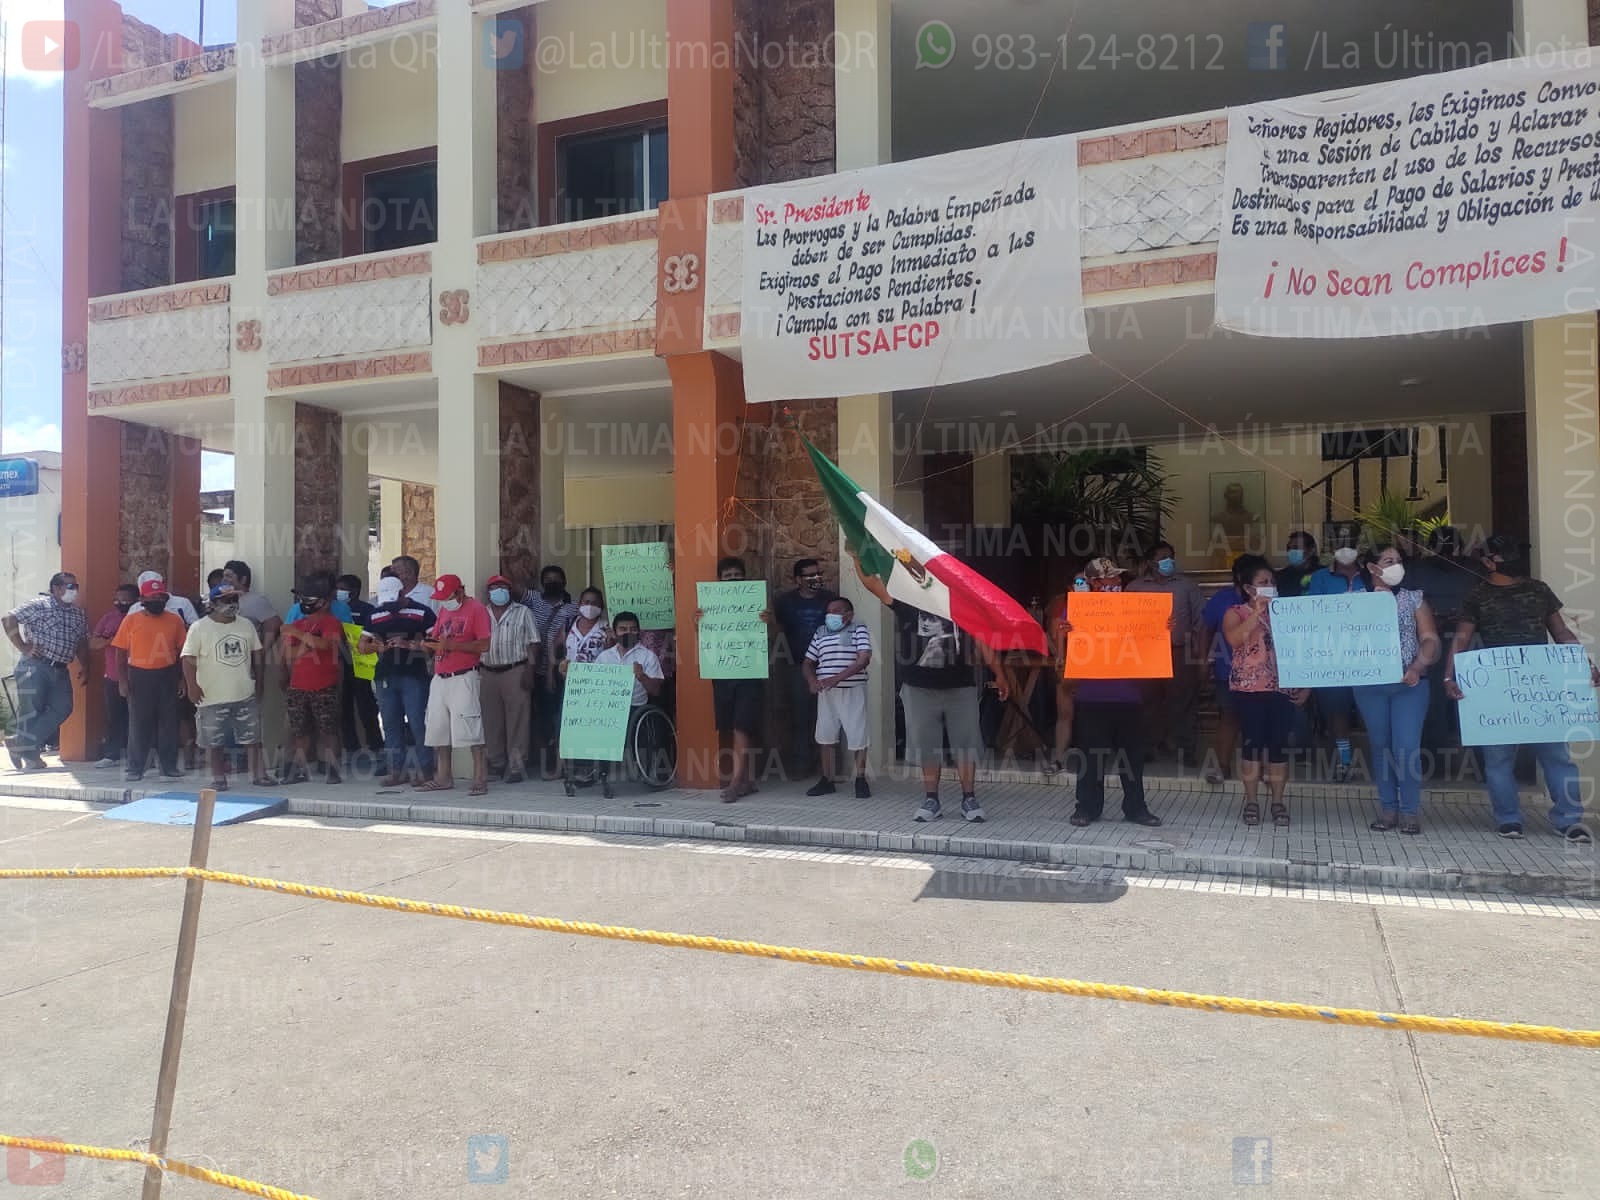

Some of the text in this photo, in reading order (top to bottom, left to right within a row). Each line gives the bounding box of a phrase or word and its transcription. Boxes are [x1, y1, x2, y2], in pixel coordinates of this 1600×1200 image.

[1277, 150, 1310, 164] una
[1317, 138, 1372, 165] Sesión
[1380, 133, 1401, 156] de
[1410, 118, 1479, 150] Cabildo
[1488, 119, 1501, 143] y
[1508, 107, 1588, 135] Aclarar
[1313, 112, 1401, 143] Regidores,
[1408, 101, 1434, 125] les
[1441, 88, 1526, 118] Exigimos
[1383, 158, 1398, 181] el
[1405, 157, 1435, 176] uso
[1446, 145, 1467, 169] de
[1475, 143, 1503, 165] los
[756, 188, 871, 226] Sr. Presidente
[783, 224, 846, 248] Prorrogas
[852, 221, 861, 241] y
[867, 213, 879, 232] la
[886, 205, 939, 228] Palabra
[946, 181, 1036, 221] Empeñada
[1232, 214, 1249, 236] Es
[1255, 220, 1288, 236] una
[1294, 206, 1428, 244] Responsabilidad
[1437, 208, 1450, 233] y
[1457, 191, 1554, 226] Obligación
[1561, 185, 1583, 209] de
[1315, 199, 1355, 221] para
[1363, 188, 1378, 211] el
[1386, 183, 1425, 211] Pago
[1432, 175, 1454, 198] de
[1461, 166, 1536, 195] Salarios
[1539, 167, 1552, 191] y
[760, 230, 1035, 295] Exigimos el Pago Inmediato a las
[792, 222, 976, 266] deben de ser Cumplidas.
[787, 269, 981, 312] Prestaciones Pendientes.
[1327, 269, 1392, 296] Sean
[846, 310, 870, 327] con
[878, 307, 895, 323] su
[808, 320, 939, 361] SUTSAFCP
[1457, 666, 1550, 689] NO Tiene
[1478, 646, 1530, 667] CHAK
[1480, 708, 1529, 727] Carrillo
